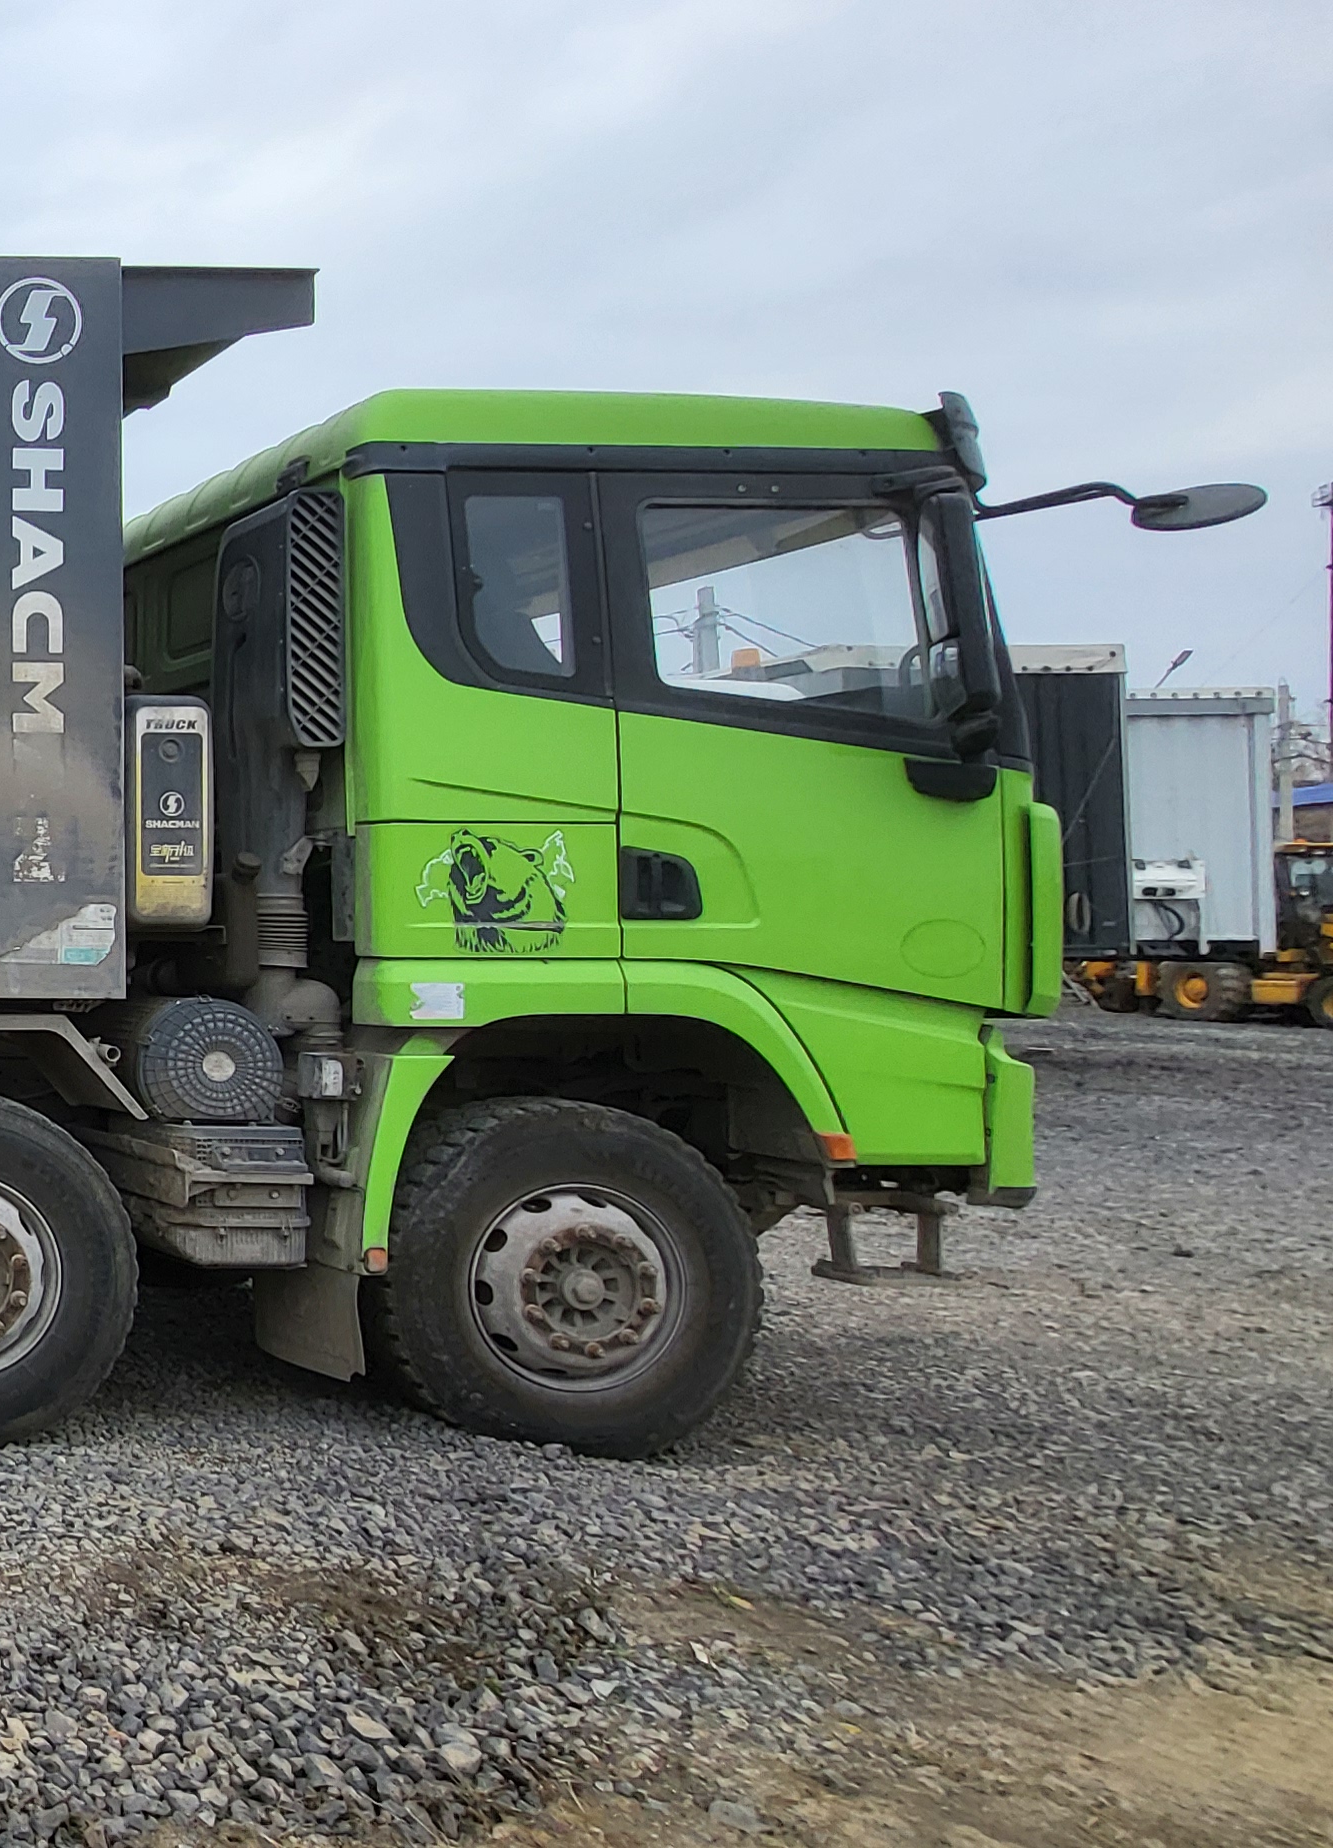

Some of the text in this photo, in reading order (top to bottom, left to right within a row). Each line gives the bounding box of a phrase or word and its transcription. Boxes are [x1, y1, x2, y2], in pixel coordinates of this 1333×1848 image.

[11, 379, 66, 883] SHACM
[145, 718, 198, 730] TRUCK
[145, 819, 200, 829] SHACMAN
